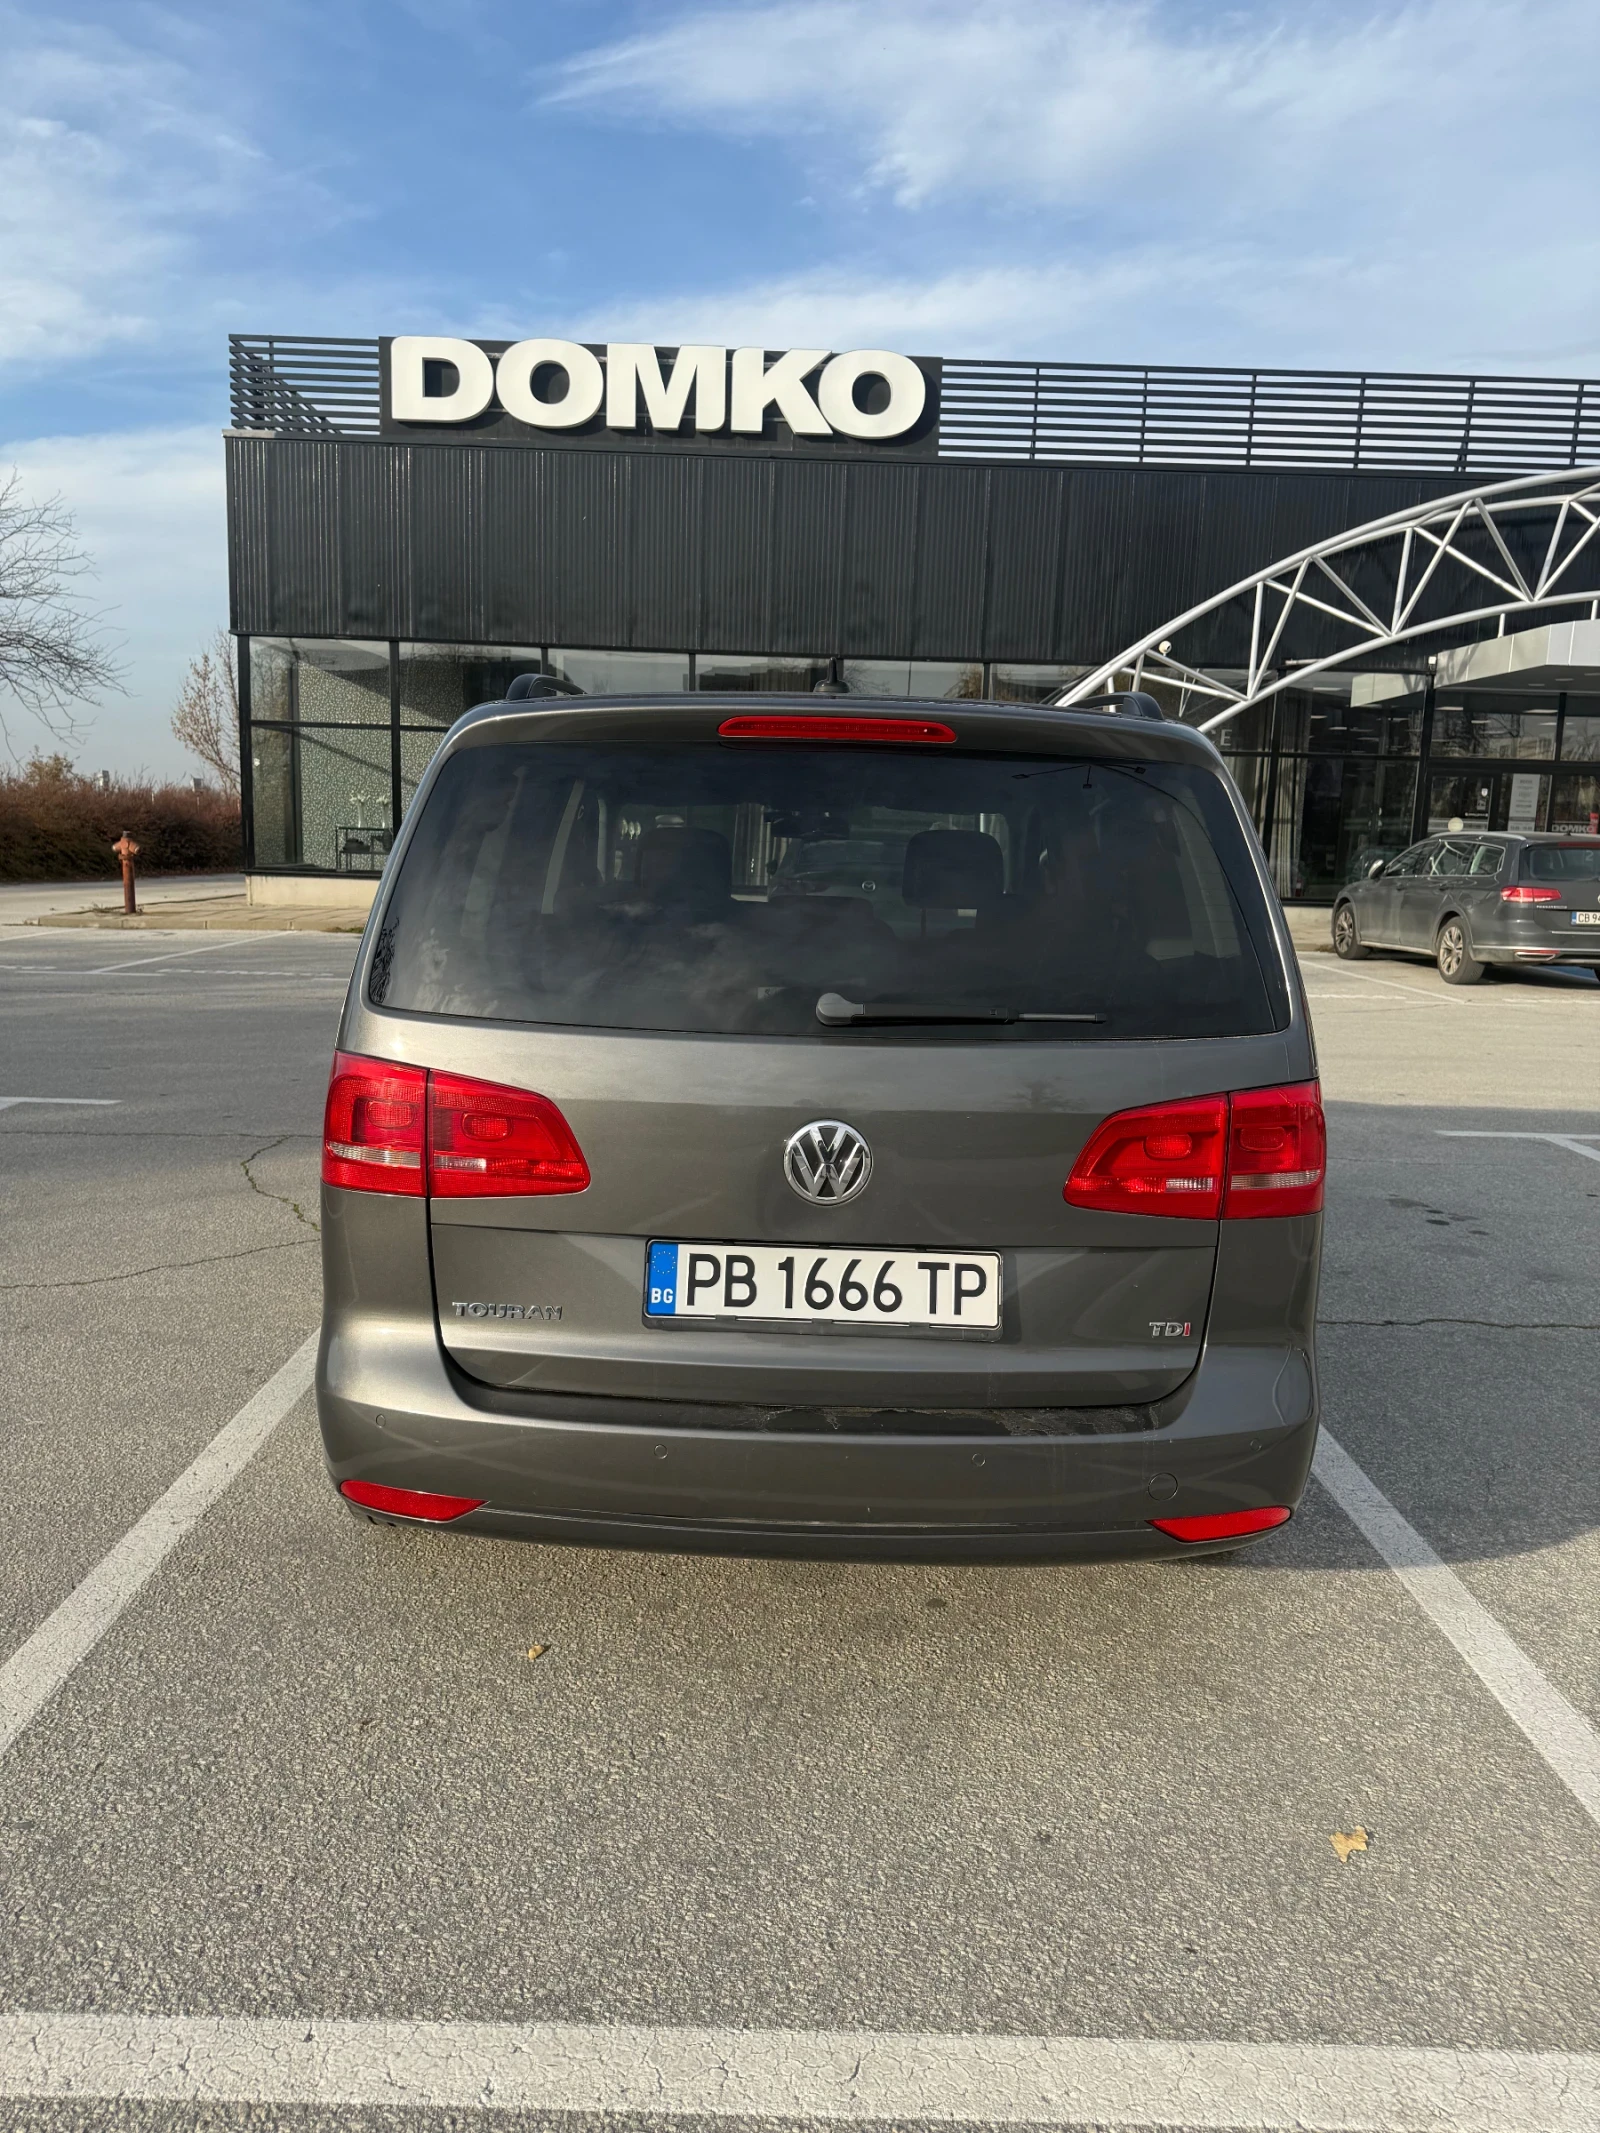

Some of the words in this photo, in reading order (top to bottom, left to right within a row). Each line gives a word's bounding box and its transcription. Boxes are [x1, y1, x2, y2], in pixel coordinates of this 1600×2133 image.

[390, 335, 926, 439] DOMKO
[1551, 823, 1594, 834] DOMKO
[1578, 913, 1590, 923] CB
[651, 1287, 674, 1304] BG
[686, 1253, 757, 1308] PB
[777, 1255, 903, 1314] 1666
[918, 1261, 987, 1316] TP
[452, 1301, 563, 1321] TOURAN
[1149, 1321, 1191, 1337] TDI
